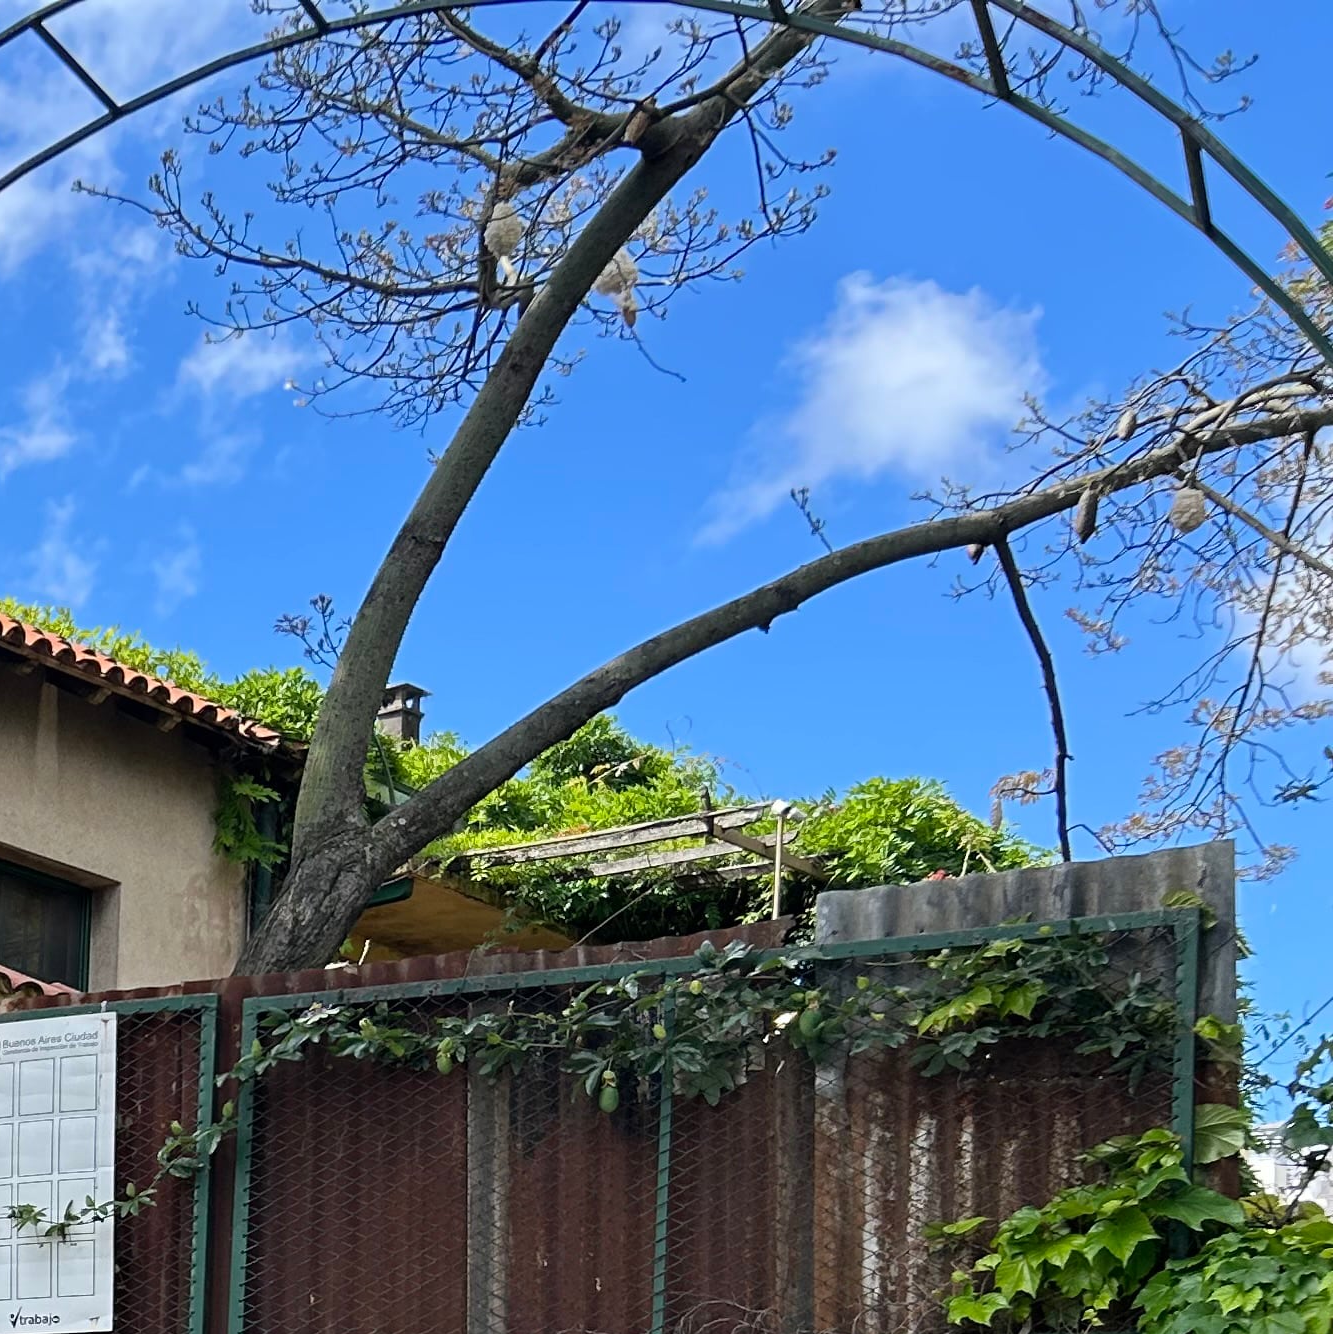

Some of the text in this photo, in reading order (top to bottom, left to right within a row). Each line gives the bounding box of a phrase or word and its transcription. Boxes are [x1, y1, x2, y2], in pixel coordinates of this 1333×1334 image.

[2, 1031, 99, 1049] Buenos Aires Ciudad
[19, 1313, 60, 1326] trabajo
